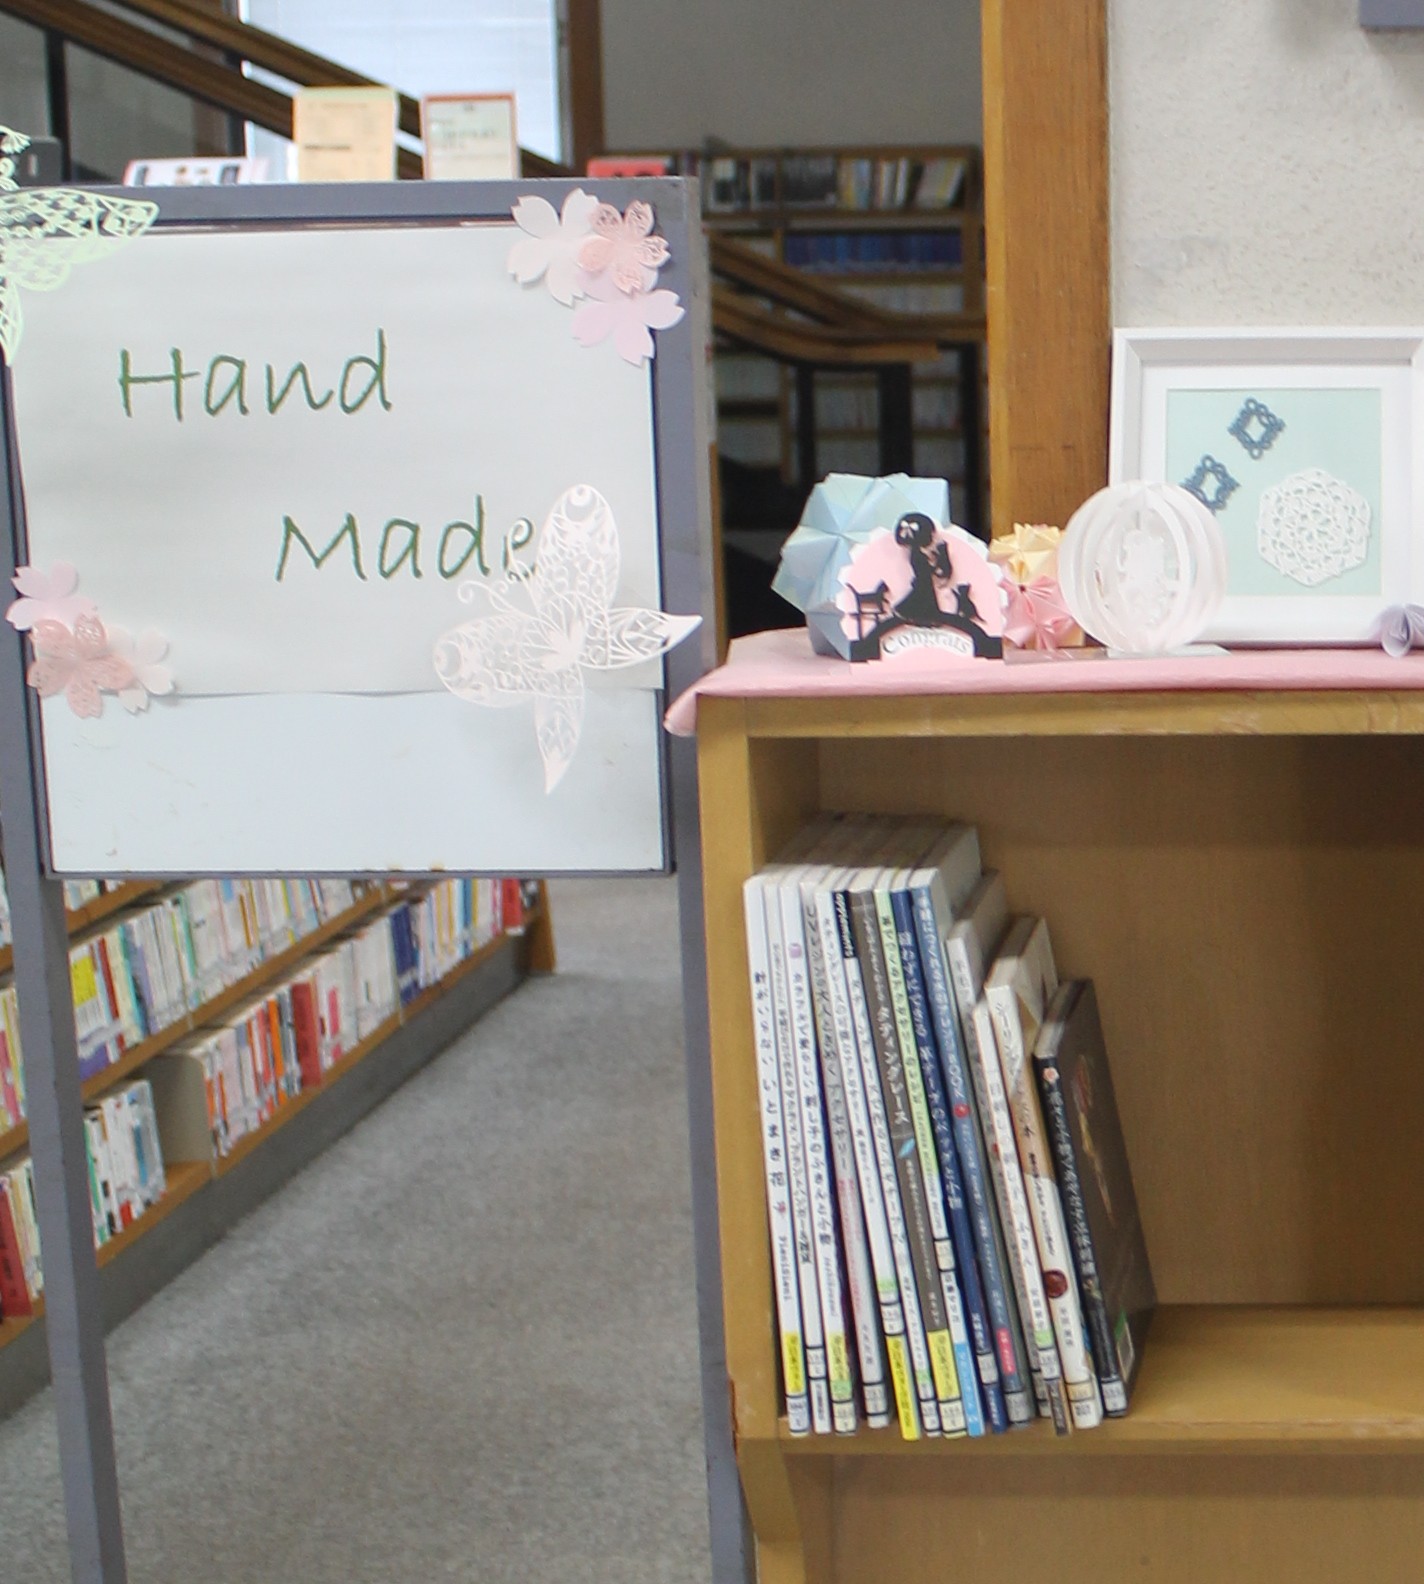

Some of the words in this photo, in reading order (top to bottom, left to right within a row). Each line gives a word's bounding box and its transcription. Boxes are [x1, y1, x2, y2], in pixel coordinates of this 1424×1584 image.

[118, 326, 392, 422] Hand
[274, 493, 537, 583] Made
[882, 628, 970, 654] Congrats
